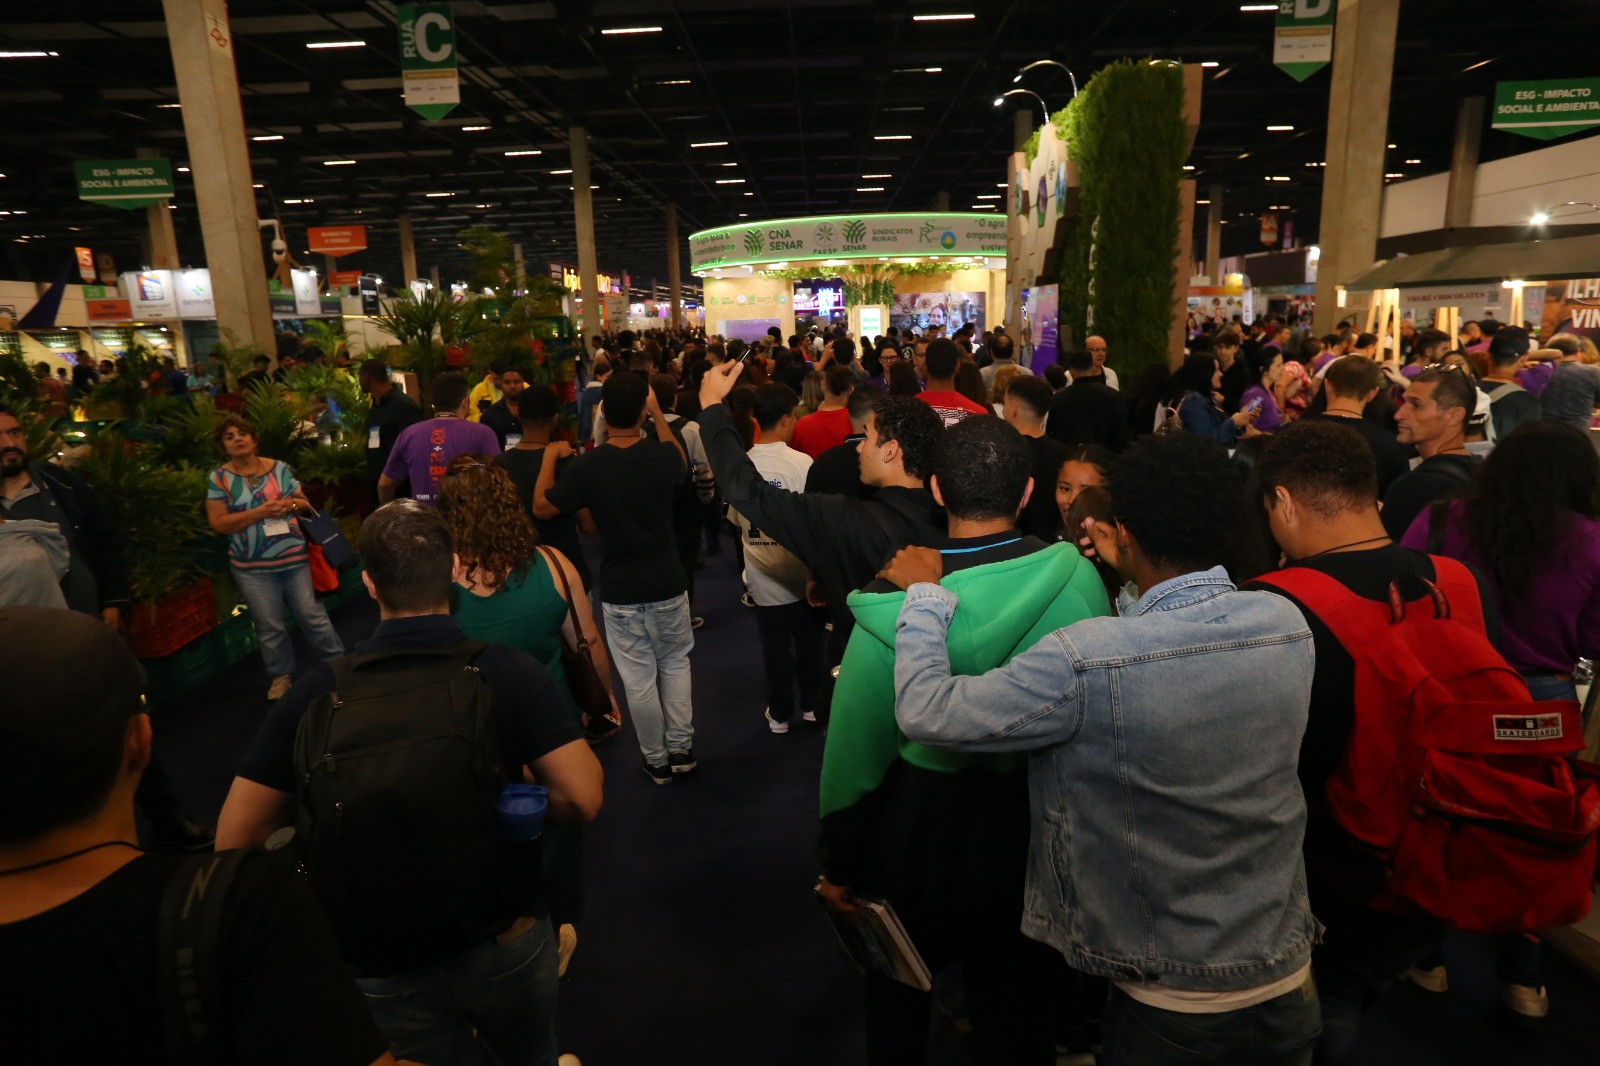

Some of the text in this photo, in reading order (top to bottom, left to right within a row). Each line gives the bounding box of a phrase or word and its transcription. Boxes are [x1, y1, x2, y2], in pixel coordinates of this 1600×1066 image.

[401, 12, 453, 62] RUA C
[1515, 90, 1536, 100] ESG
[1543, 88, 1592, 99] IMPACTO
[1497, 104, 1534, 114] SOCIAL
[1536, 104, 1543, 113] E
[92, 169, 111, 177] ESG
[116, 167, 154, 176] IMPACTO
[81, 180, 113, 188] SOCIAL
[121, 178, 169, 187] AMBIENTAL
[988, 220, 1005, 229] agro
[768, 229, 792, 240] CNA
[872, 228, 914, 236] SINDICATOS
[769, 240, 804, 251] SENAR
[1433, 292, 1486, 302] CHOCOLATES
[1496, 729, 1560, 737] SKATEBOARDS
